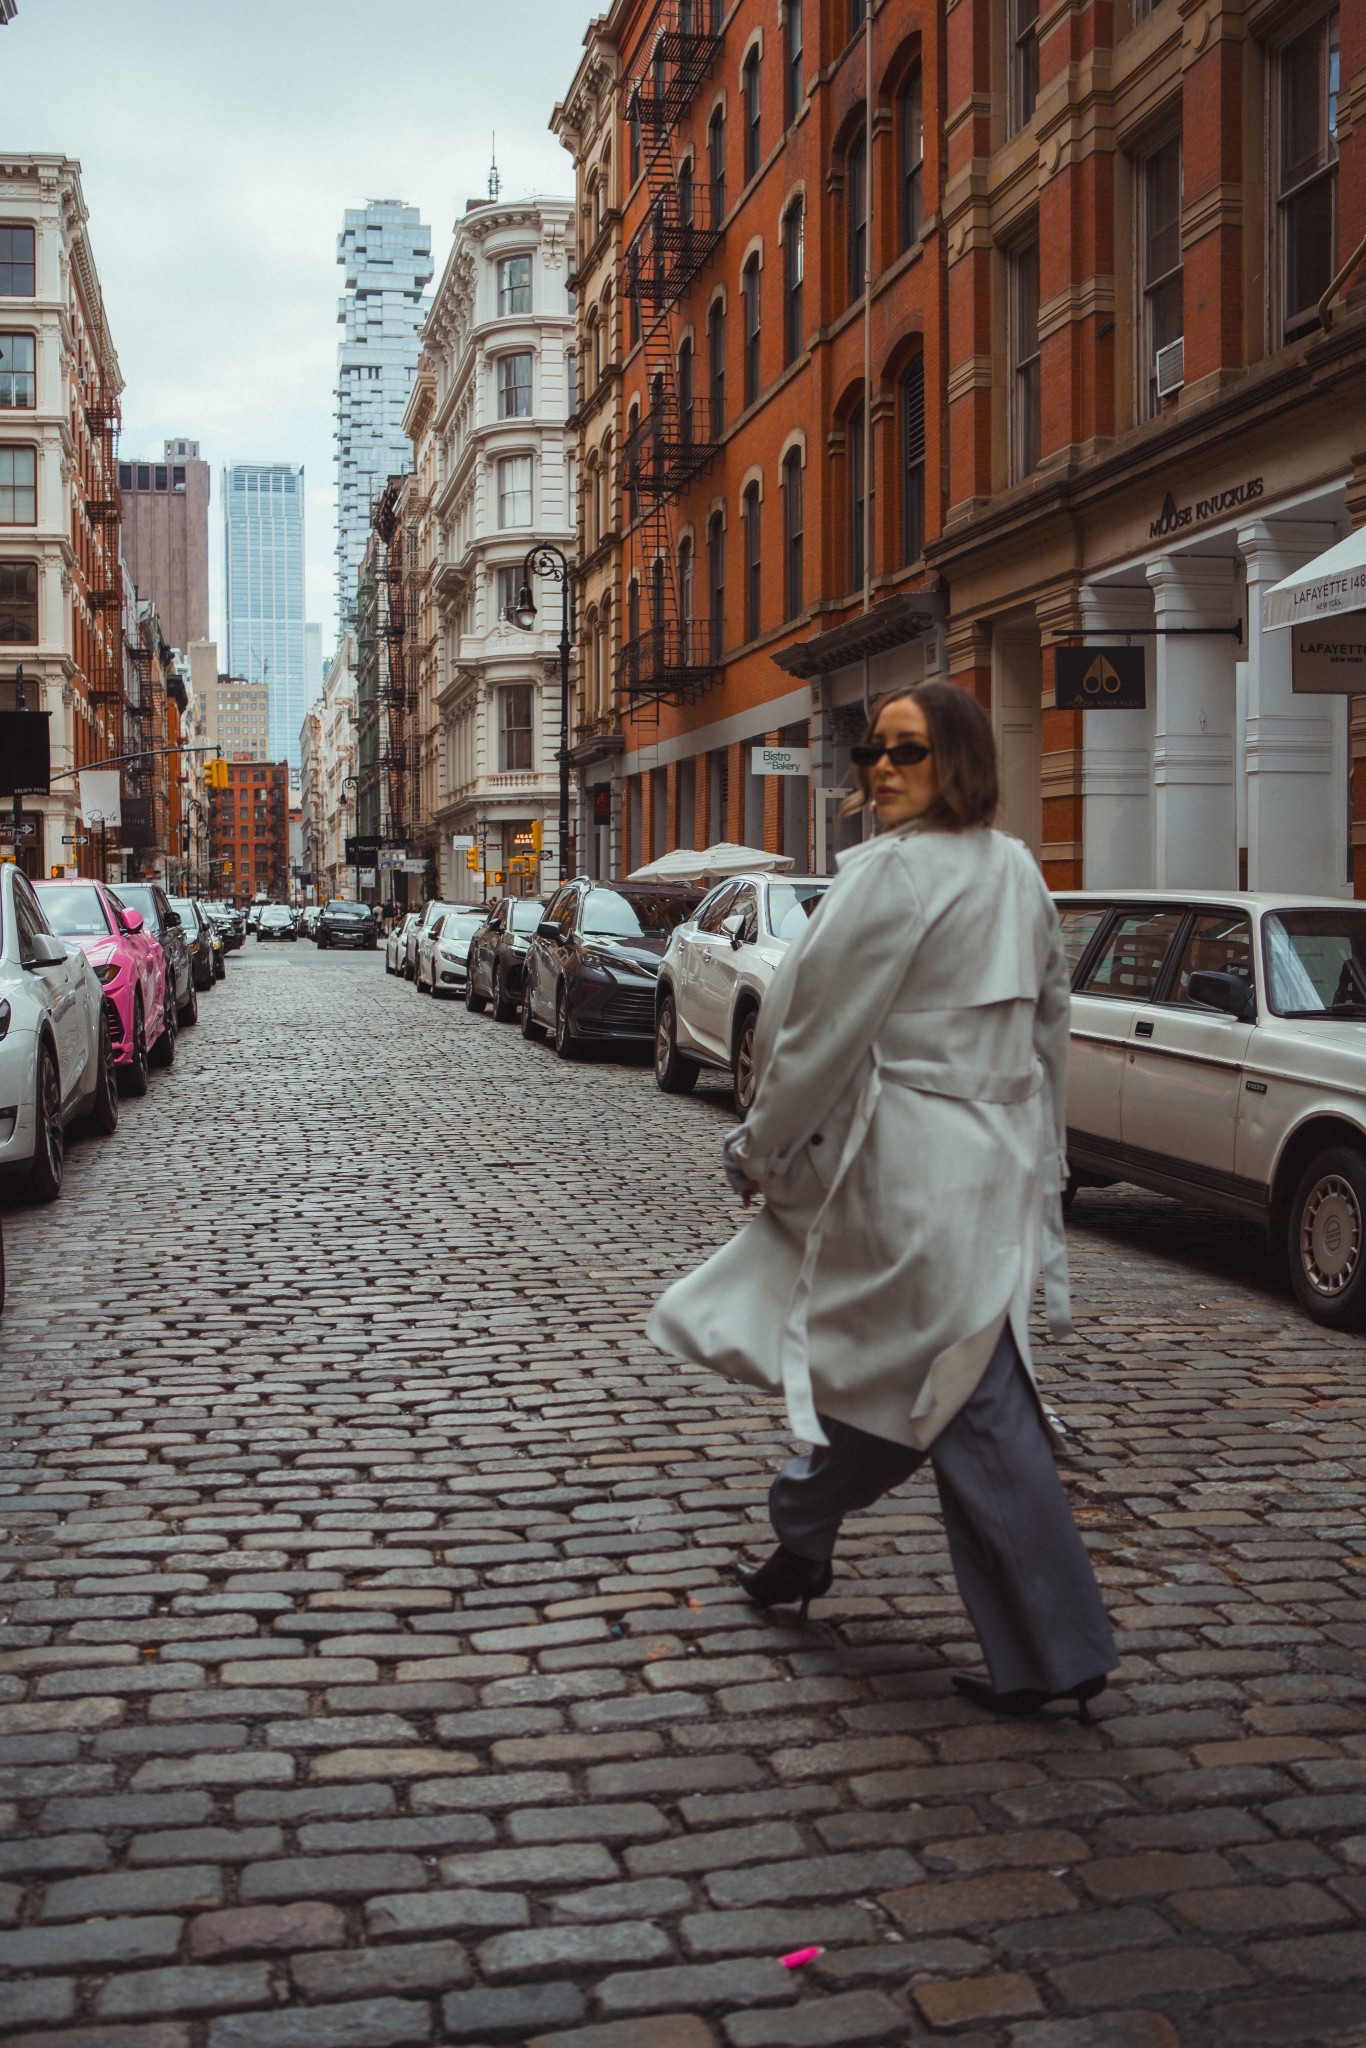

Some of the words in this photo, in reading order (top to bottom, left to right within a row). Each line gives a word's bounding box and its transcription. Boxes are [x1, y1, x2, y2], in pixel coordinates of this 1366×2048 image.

[1149, 504, 1192, 538] MOOSE
[1195, 477, 1264, 520] KNUCKLES
[1294, 578, 1348, 605] LAFAYETTE
[1350, 573, 1366, 590] 148
[1316, 602, 1328, 611] NEW
[1328, 599, 1342, 608] YORK
[763, 750, 791, 762] Bistro
[772, 761, 800, 772] Bakery
[1247, 1082, 1265, 1091] VOLVO
